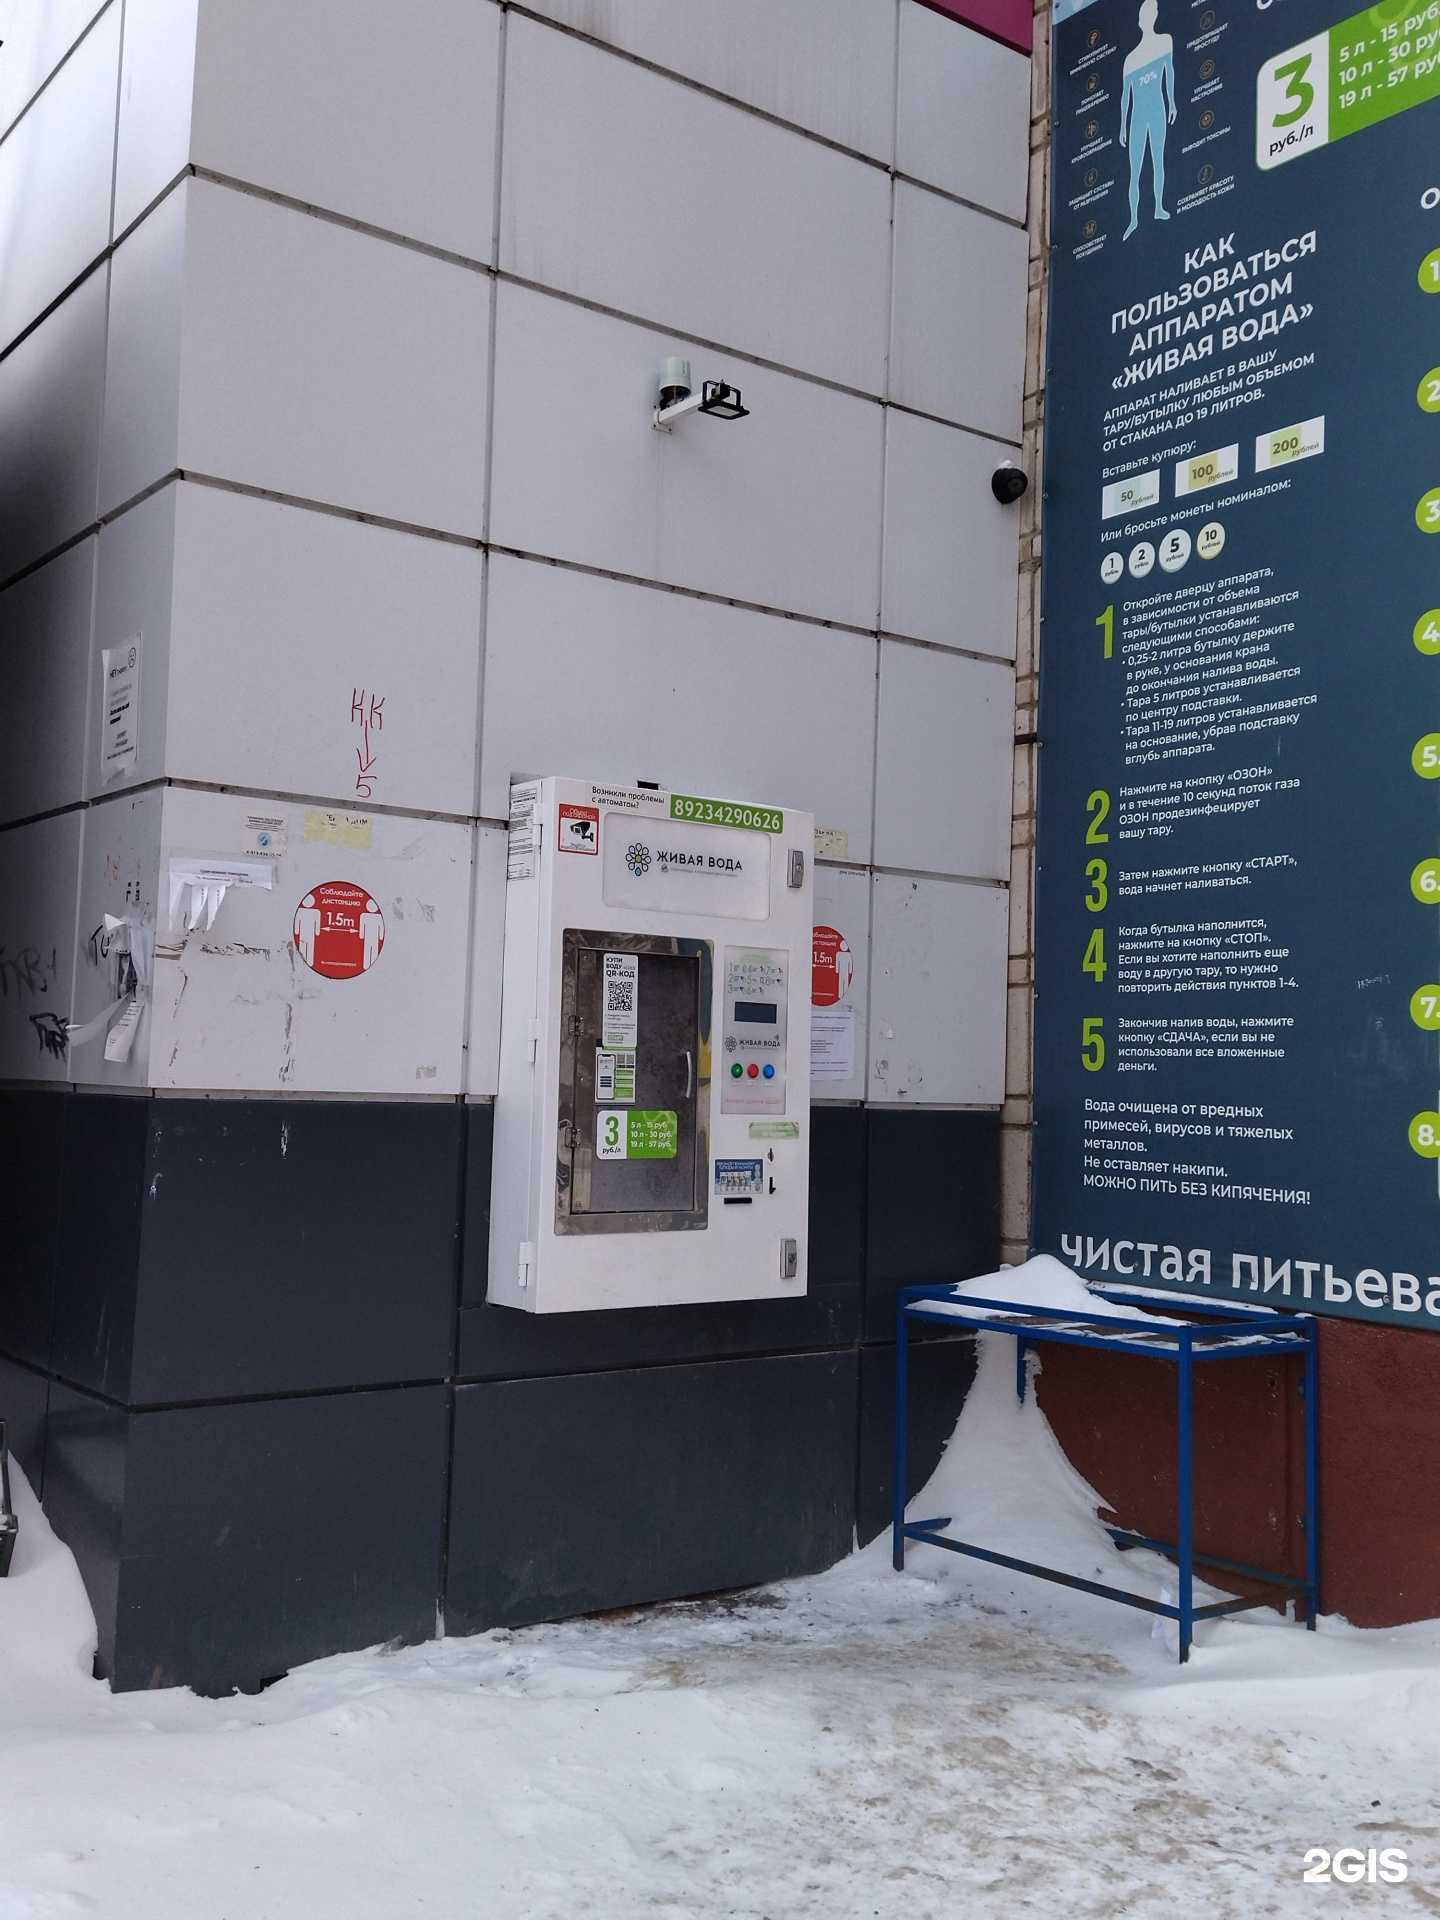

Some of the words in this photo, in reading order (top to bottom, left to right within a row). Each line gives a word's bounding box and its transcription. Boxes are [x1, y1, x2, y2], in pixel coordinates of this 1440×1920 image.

[1380, 23, 1397, 42] 15
[1339, 67, 1357, 85] 10
[1388, 42, 1410, 63] 30
[1272, 53, 1314, 128] 3
[1339, 91, 1356, 108] 19
[1387, 66, 1408, 87] 57
[1270, 124, 1313, 156] руб./л
[1185, 233, 1234, 273] КАК
[1112, 230, 1315, 333] ПОЛЬЗОВАТЬСЯ
[1130, 272, 1291, 355] АППАРАТОМ
[1112, 335, 1212, 389] «ЖИВАЯ
[1222, 304, 1313, 350] ВОДА»
[1104, 393, 1156, 421] АППАРАТ
[1159, 368, 1224, 401] НАЛИВАЕТ
[1239, 349, 1276, 372] ВАШУ
[1104, 397, 1189, 436] ТАРУ/БУТЫЛКУ
[1192, 378, 1242, 405] ЛЮБЫМ
[1246, 352, 1314, 385] ОБЪЕМОМ
[1120, 420, 1172, 445] СТАКАНА
[1196, 407, 1207, 419] 19
[1210, 388, 1264, 415] ЛИТРОВ.
[1102, 456, 1148, 478] Вставьте
[1151, 440, 1196, 463] купюру:
[1272, 437, 1299, 455] 200
[1192, 464, 1214, 480] 100
[1101, 529, 1121, 542] Или
[1124, 516, 1167, 535] бросьте
[1170, 502, 1214, 521] монеты
[1217, 479, 1290, 508] номиналом:
[1120, 490, 1134, 503] 50
[1205, 529, 1216, 542] 10
[1123, 593, 1172, 611] Откройте
[1174, 582, 1215, 600] дверцу
[1218, 568, 1273, 587] аппарата,
[1122, 616, 1195, 639] тары/бутылки
[1198, 591, 1298, 624] устанавливаются
[1131, 600, 1199, 623] зависимости
[1217, 586, 1259, 602] объема
[1096, 604, 1114, 659] 1
[1122, 631, 1191, 653] следующими
[1195, 615, 1259, 636] способами:
[1128, 651, 1157, 666] 0,25-2
[1159, 646, 1191, 659] литра
[1194, 634, 1240, 652] бутылку
[1242, 622, 1294, 642] держите
[1135, 666, 1161, 680] руке,
[1173, 651, 1232, 670] основания
[1235, 643, 1269, 658] крана
[1142, 672, 1199, 690] окончания
[1202, 664, 1242, 679] налива
[1246, 657, 1278, 670] воды.
[1127, 696, 1150, 708] Тара
[1162, 687, 1200, 701] литров
[1203, 667, 1300, 696] устанавливается
[1126, 725, 1149, 736] Тара
[1152, 719, 1173, 731] 11-19
[1176, 713, 1215, 727] литров
[1217, 694, 1317, 722] устанавливается
[1141, 705, 1178, 720] центру
[1181, 694, 1242, 712] подставки.
[1140, 731, 1200, 747] основание,
[1203, 724, 1235, 739] убрав
[1239, 713, 1299, 731] подставку
[1125, 750, 1160, 764] вглубь
[1162, 743, 1214, 758] аппарата.
[356, 774, 377, 798] 5
[592, 786, 627, 799] Возникли
[628, 791, 665, 804] проблемы
[1120, 783, 1167, 796] Нажмите
[1185, 774, 1224, 787] кнопку
[1228, 767, 1272, 780] «ОЗОН»
[1137, 796, 1180, 808] течение
[1183, 791, 1193, 802] 10
[1196, 788, 1235, 800] секунд
[1239, 782, 1271, 794] поток
[1275, 779, 1299, 789] газа
[597, 796, 639, 809] автоматом?
[674, 800, 780, 830] 89234290626
[1119, 812, 1148, 824] ОЗОН
[1152, 799, 1260, 822] продезинфецирует
[1086, 790, 1111, 845] 2
[1120, 828, 1145, 838] вашу
[1148, 825, 1173, 836] тару.
[656, 851, 703, 867] ЖИВАЯ
[709, 856, 743, 871] ВОДА
[1119, 871, 1148, 880] Затем
[1152, 866, 1199, 877] нажмите
[1203, 862, 1242, 872] кнопку
[1245, 855, 1297, 868] «СТАРТ»,
[320, 888, 363, 898] Соблюдайте
[1085, 858, 1108, 912] 3
[1119, 886, 1142, 895] вода
[1146, 882, 1182, 892] начнет
[1185, 876, 1251, 889] наливаться.
[322, 898, 360, 906] дистанцию
[326, 912, 354, 927] 1.5m
[1119, 926, 1147, 936] Когда
[1150, 924, 1194, 936] бутылка
[1198, 919, 1266, 930] наполнится,
[1082, 928, 1108, 982] 4
[1119, 940, 1164, 950] нажмите
[1183, 937, 1221, 947] кнопку
[1225, 932, 1271, 944] «СТОП».
[1119, 955, 1142, 964] Если
[1162, 953, 1197, 962] хотите
[1200, 950, 1261, 960] наполнить
[1264, 948, 1289, 957] еще
[1118, 970, 1142, 980] воду
[1153, 968, 1192, 979] другую
[1195, 967, 1222, 977] тару,
[1240, 964, 1278, 976] нужно
[1118, 984, 1171, 994] повторить
[1174, 981, 1226, 992] действия
[1229, 980, 1276, 991] пунктов
[1279, 977, 1298, 987] 1-4.
[1118, 1018, 1167, 1027] Закончив
[1170, 1019, 1203, 1027] налив
[1206, 1018, 1237, 1028] воды,
[1241, 1018, 1293, 1026] нажмите
[1082, 1018, 1105, 1072] 5
[1118, 1034, 1154, 1044] кнопку
[1157, 1032, 1208, 1043] «СДАЧА»,
[1118, 1048, 1192, 1056] использовали
[1195, 1048, 1214, 1056] все
[1217, 1048, 1284, 1057] вложенные
[1118, 1062, 1156, 1071] деньги.
[1085, 1099, 1114, 1112] Вода
[1118, 1102, 1177, 1114] очищена
[1200, 1105, 1263, 1118] вредных
[605, 1116, 619, 1146] 3
[1085, 1120, 1151, 1134] примесей,
[1155, 1123, 1211, 1136] вирусов
[1227, 1126, 1293, 1139] тяжелых
[1084, 1139, 1147, 1151] металлов.
[1104, 1159, 1169, 1172] оставляет
[1173, 1164, 1227, 1176] накипи.
[1084, 1174, 1136, 1189] МОЖНО
[1140, 1178, 1176, 1192] ПИТЬ
[1181, 1182, 1206, 1195] БЕЗ
[1212, 1184, 1310, 1204] КИПЯЧЕНИЯ!
[1062, 1234, 1210, 1284] чистая
